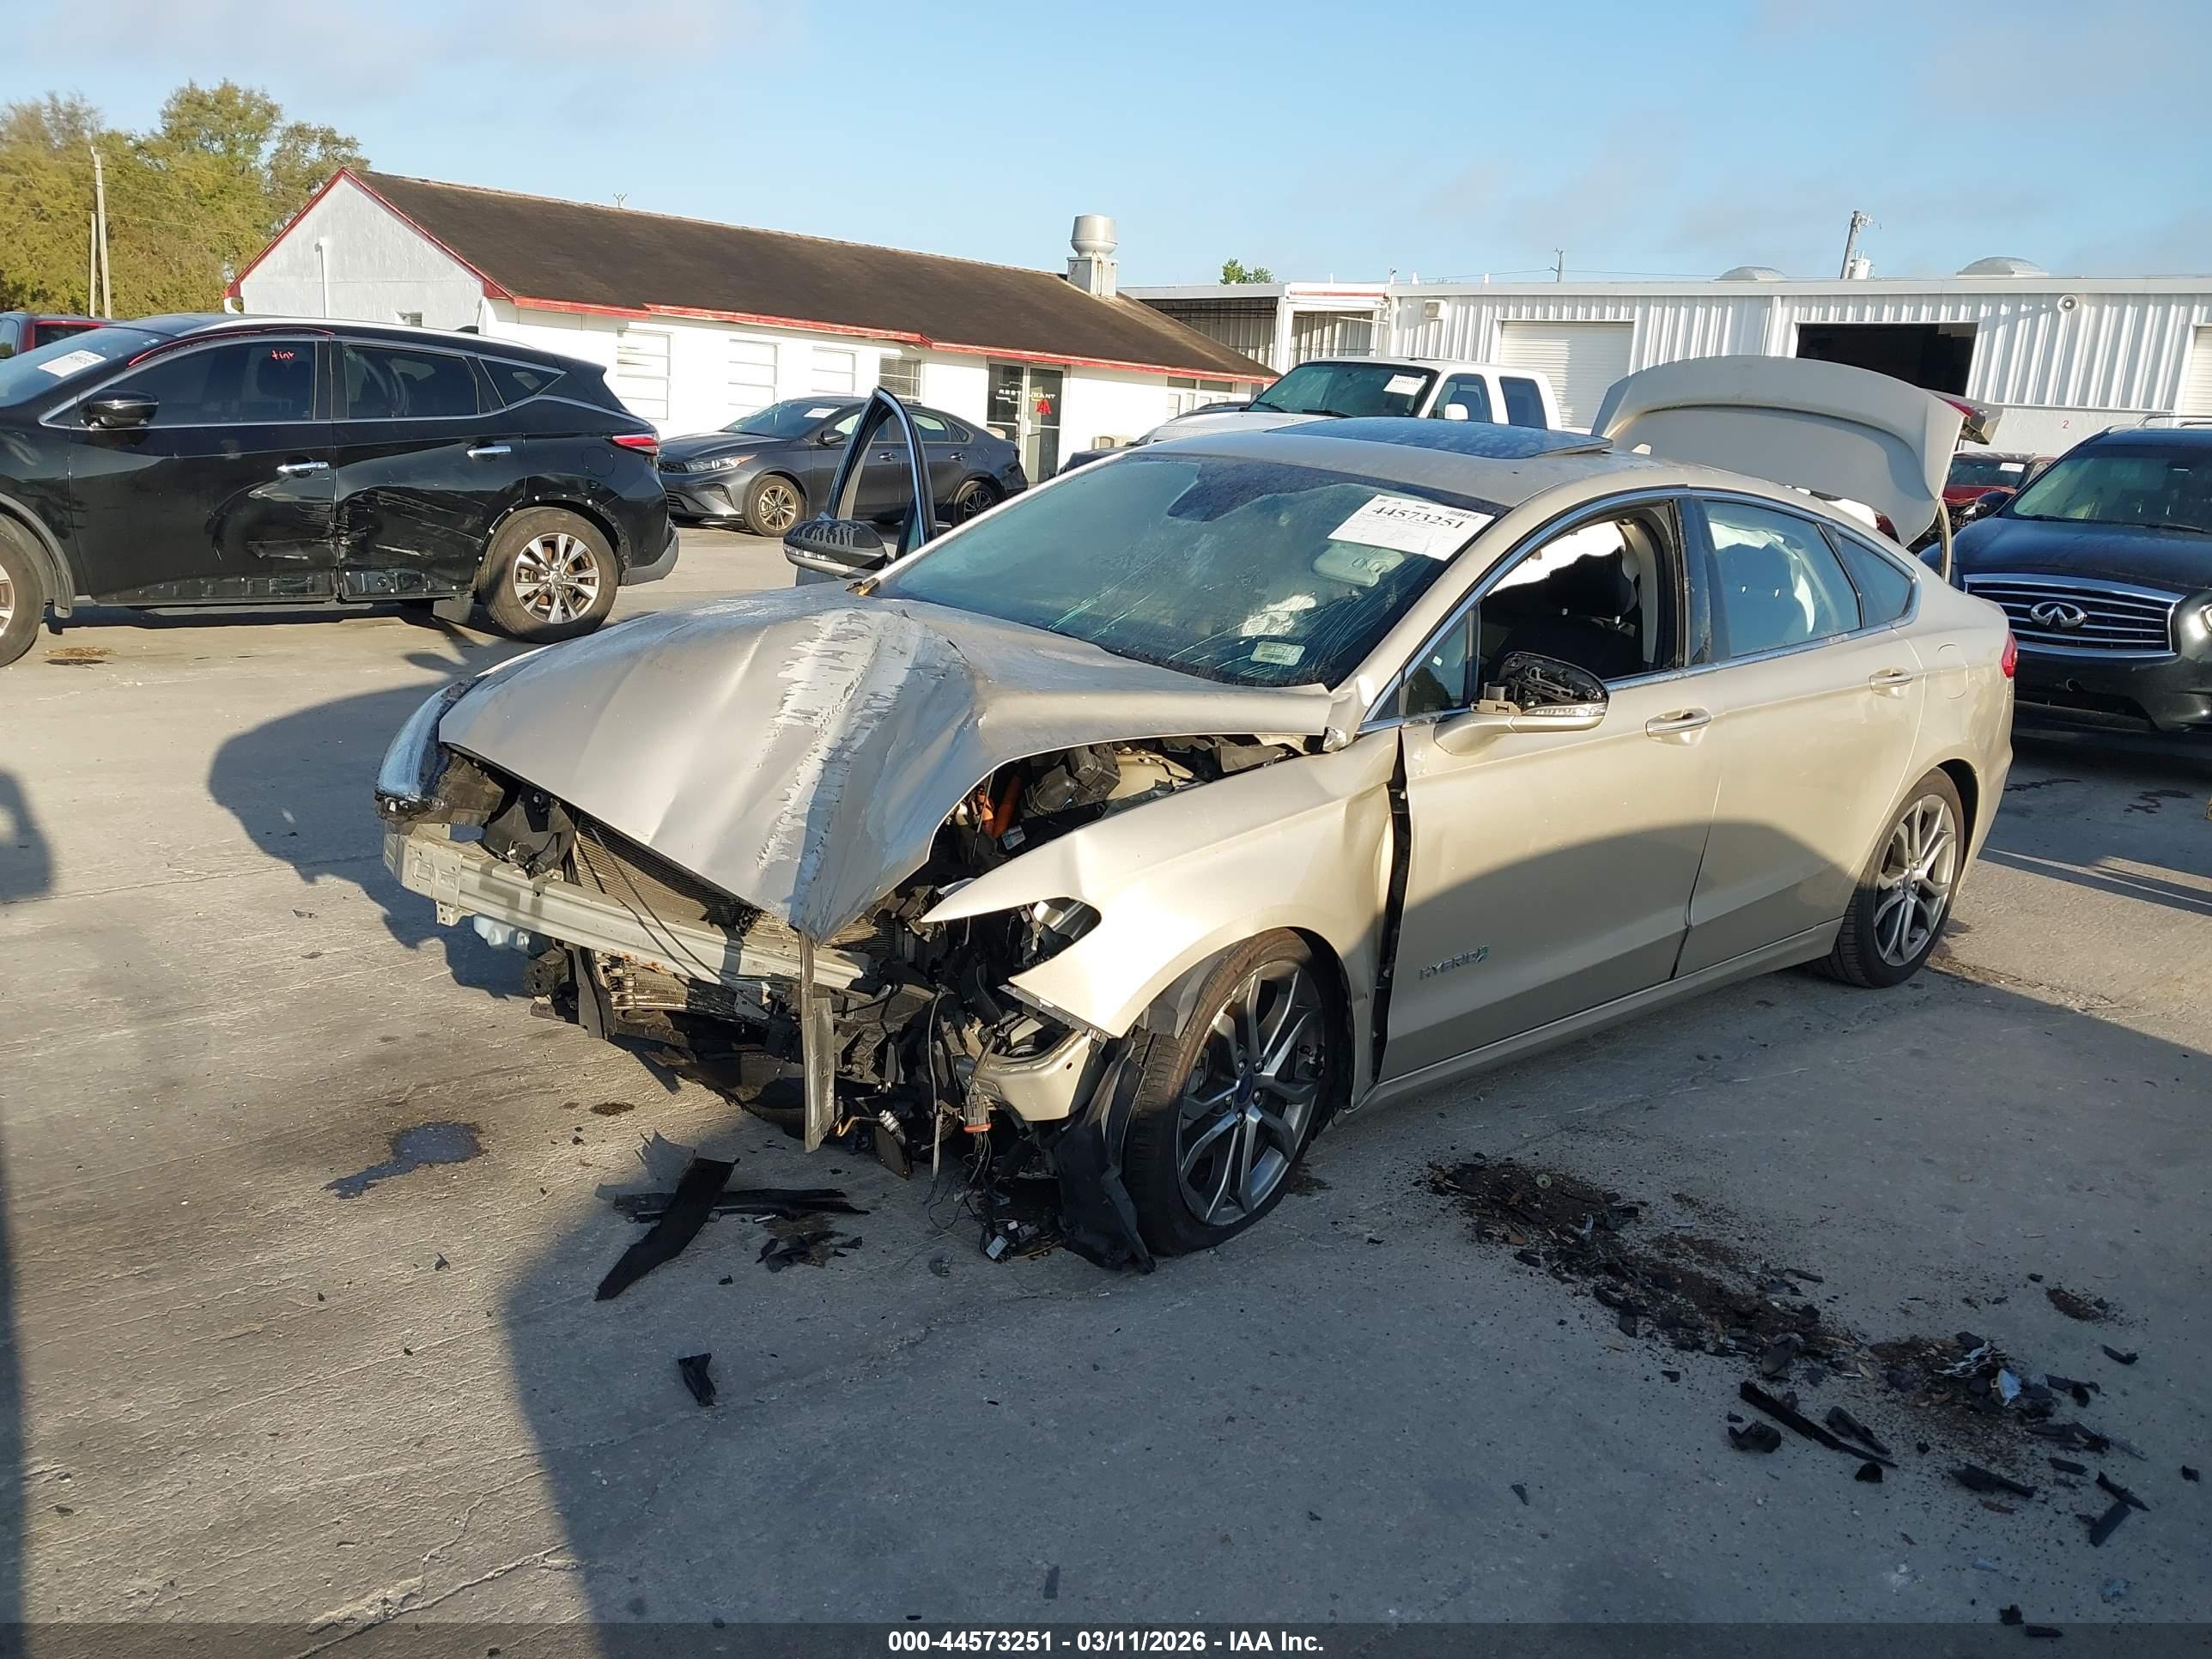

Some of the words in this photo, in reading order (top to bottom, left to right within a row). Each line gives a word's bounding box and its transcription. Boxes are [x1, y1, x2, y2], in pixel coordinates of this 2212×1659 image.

[2061, 419, 2069, 429] 2
[1372, 507, 1465, 529] 44573251
[1419, 951, 1479, 981] HYBRID
